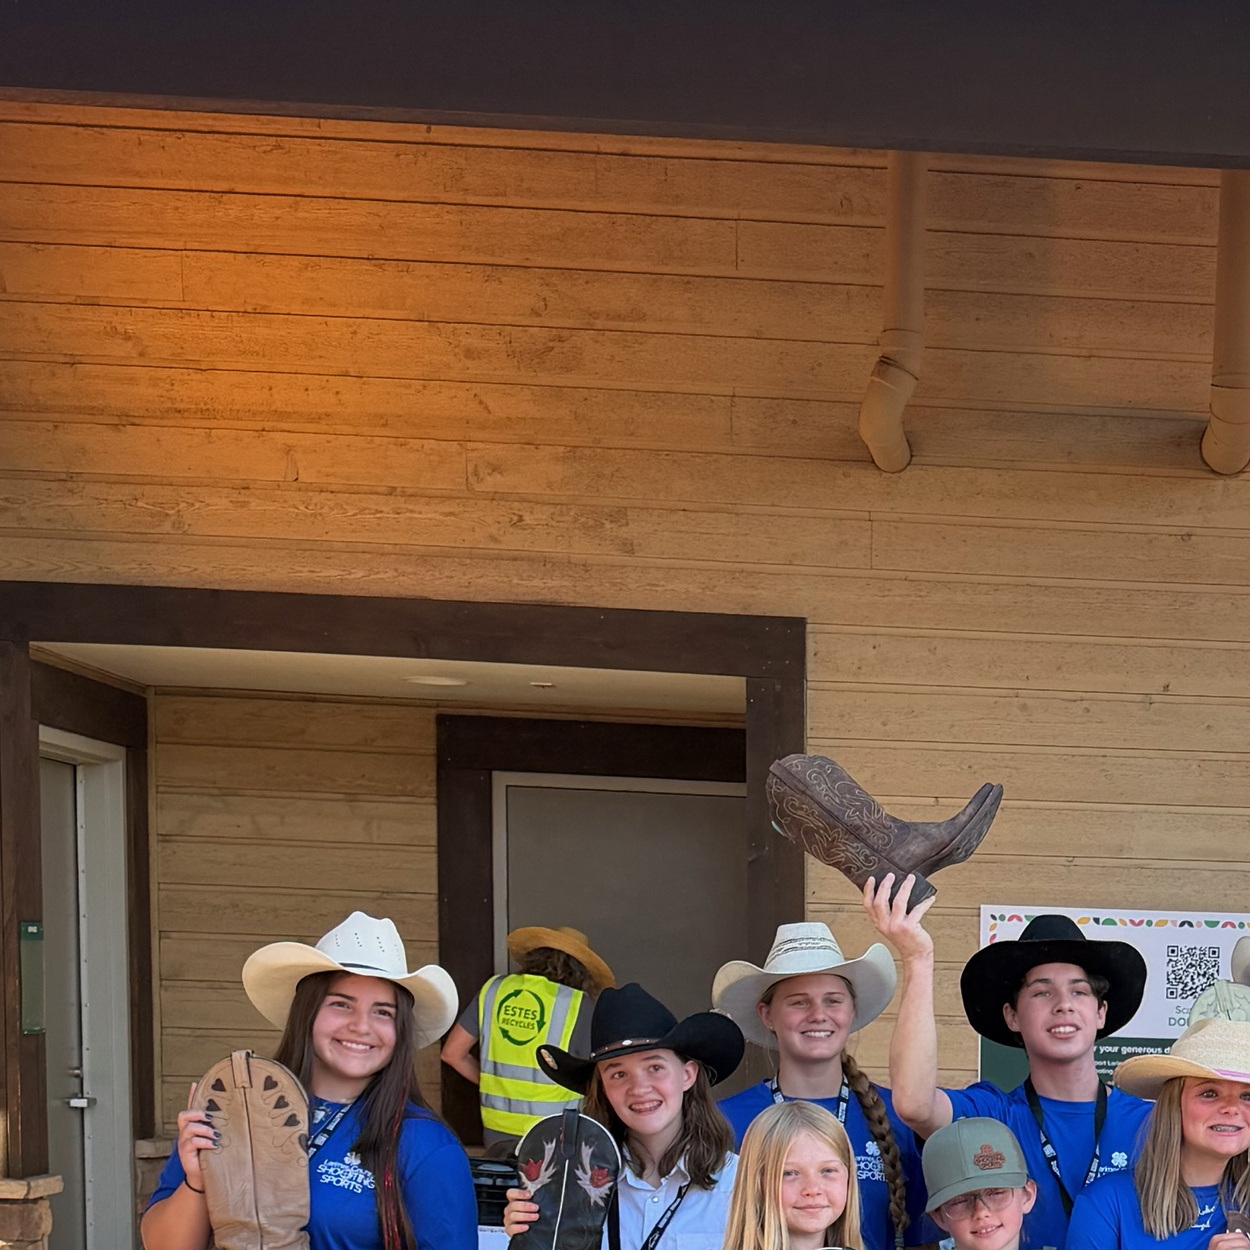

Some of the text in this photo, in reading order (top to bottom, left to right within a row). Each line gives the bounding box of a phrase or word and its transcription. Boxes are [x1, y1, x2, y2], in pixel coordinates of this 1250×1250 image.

[504, 1005, 538, 1021] ESTES
[501, 1018, 536, 1031] RECYCLES
[1100, 1045, 1118, 1055] your
[1121, 1046, 1162, 1055] generous
[316, 1164, 376, 1189] SHOOTING
[320, 1174, 363, 1194] SPORTS
